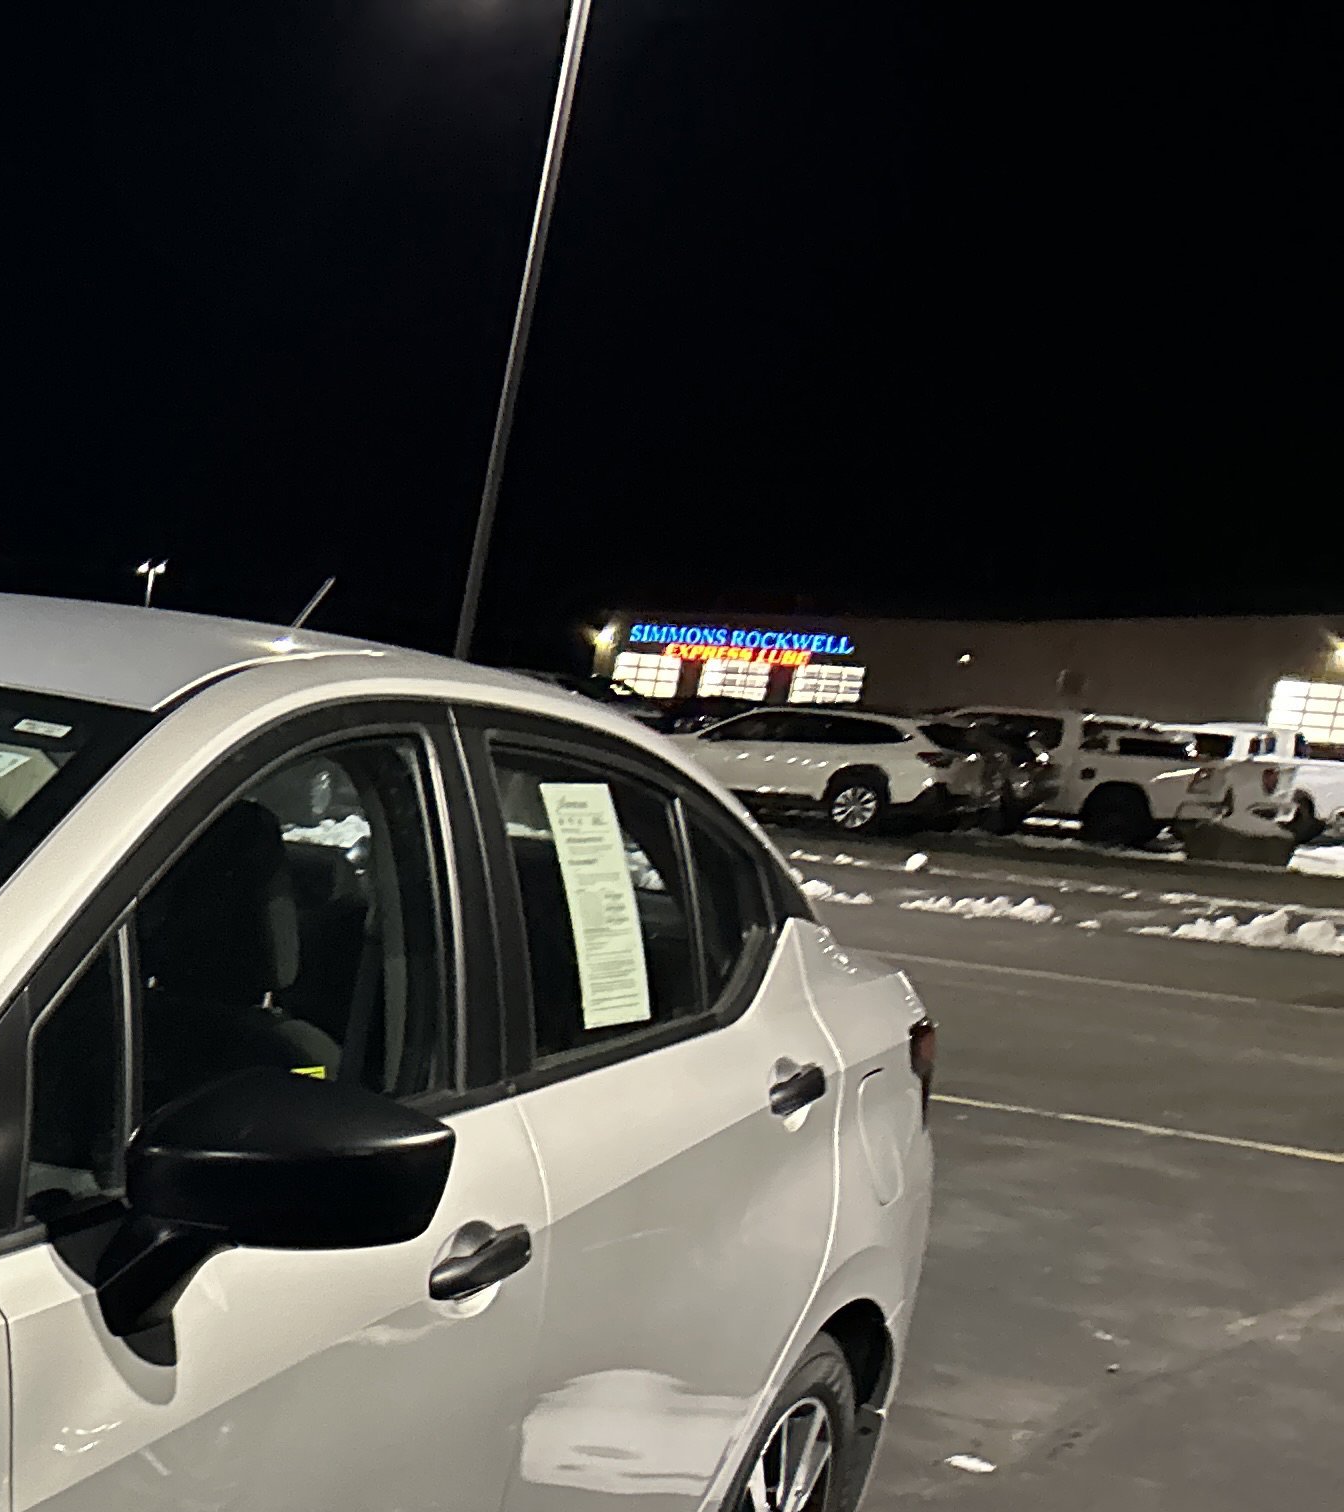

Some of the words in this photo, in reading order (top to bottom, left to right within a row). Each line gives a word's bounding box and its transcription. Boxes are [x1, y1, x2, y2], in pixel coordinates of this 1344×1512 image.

[629, 624, 728, 647] SIMMONS
[730, 630, 855, 655] ROCKWELL
[665, 643, 755, 663] EXPRESS
[757, 650, 811, 667] LUBE
